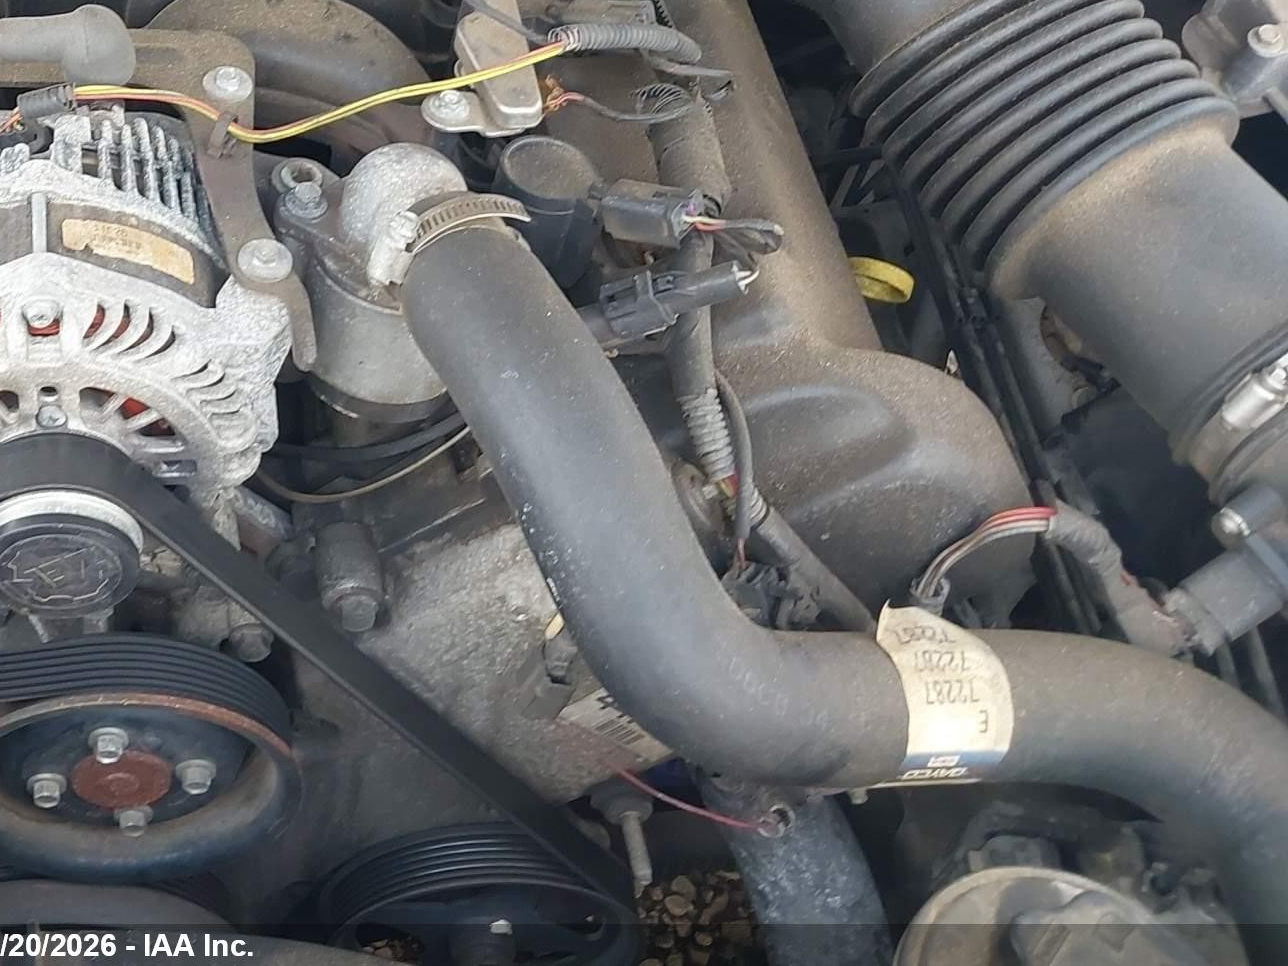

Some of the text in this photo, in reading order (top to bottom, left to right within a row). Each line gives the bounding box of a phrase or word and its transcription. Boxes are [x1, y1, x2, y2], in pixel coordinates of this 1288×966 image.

[913, 649, 971, 673] 72287
[924, 679, 981, 705] 72287
[978, 709, 989, 734] E
[901, 767, 968, 780] DAYCO
